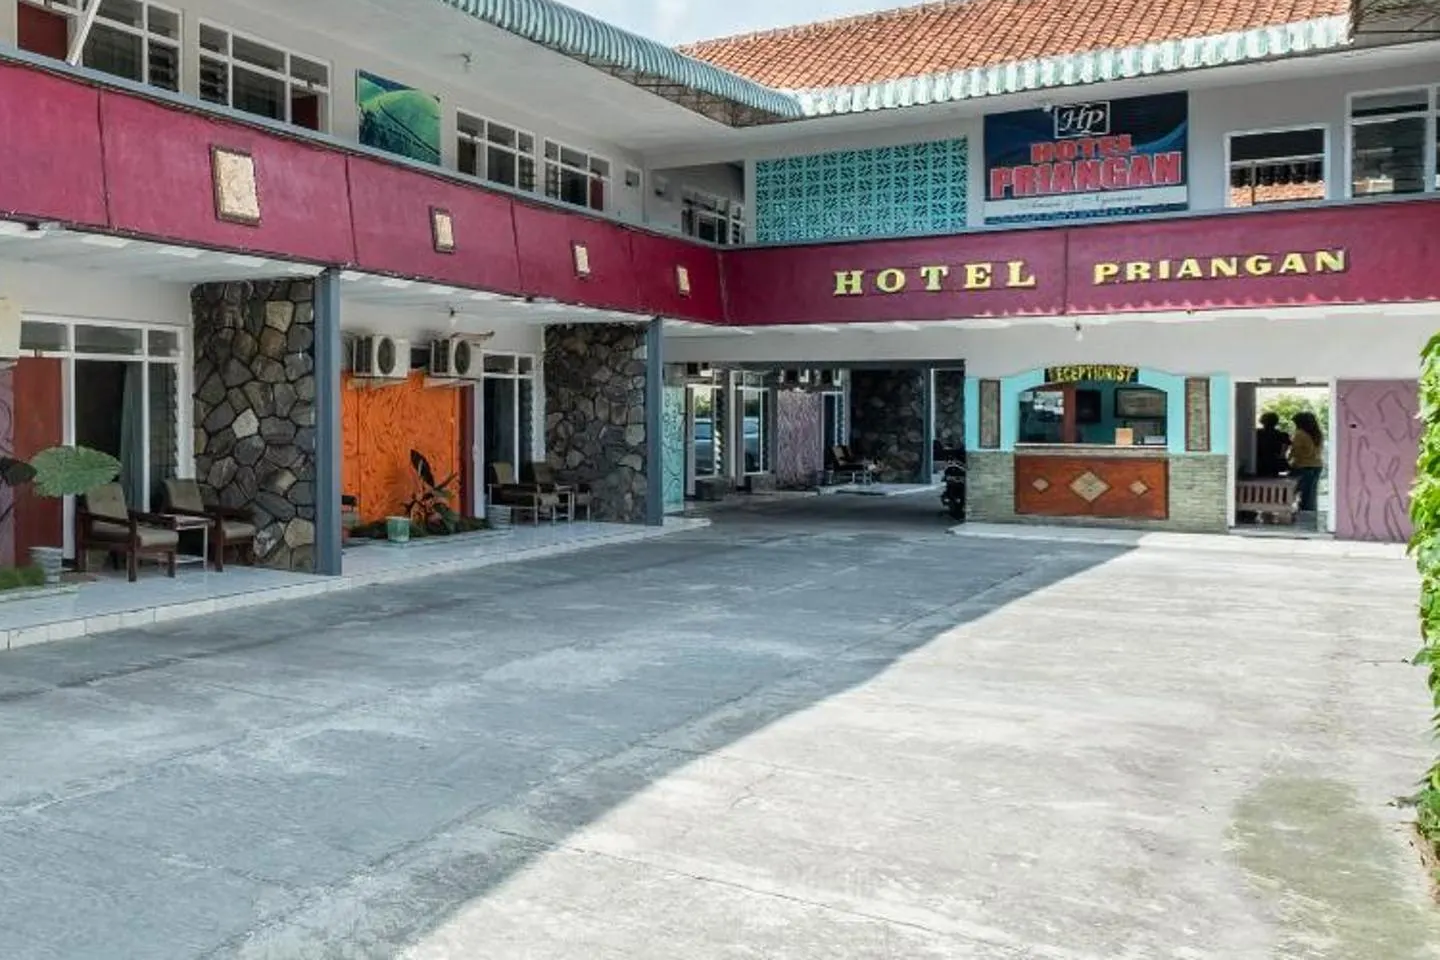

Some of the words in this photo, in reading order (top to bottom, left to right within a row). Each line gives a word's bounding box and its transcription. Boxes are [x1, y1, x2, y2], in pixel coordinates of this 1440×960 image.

[1059, 104, 1105, 134] HP
[1031, 134, 1133, 163] HOTEL
[990, 151, 1182, 200] PRIANGAN
[833, 260, 1036, 295] HOTEL
[1093, 249, 1345, 285] PRIANGAN
